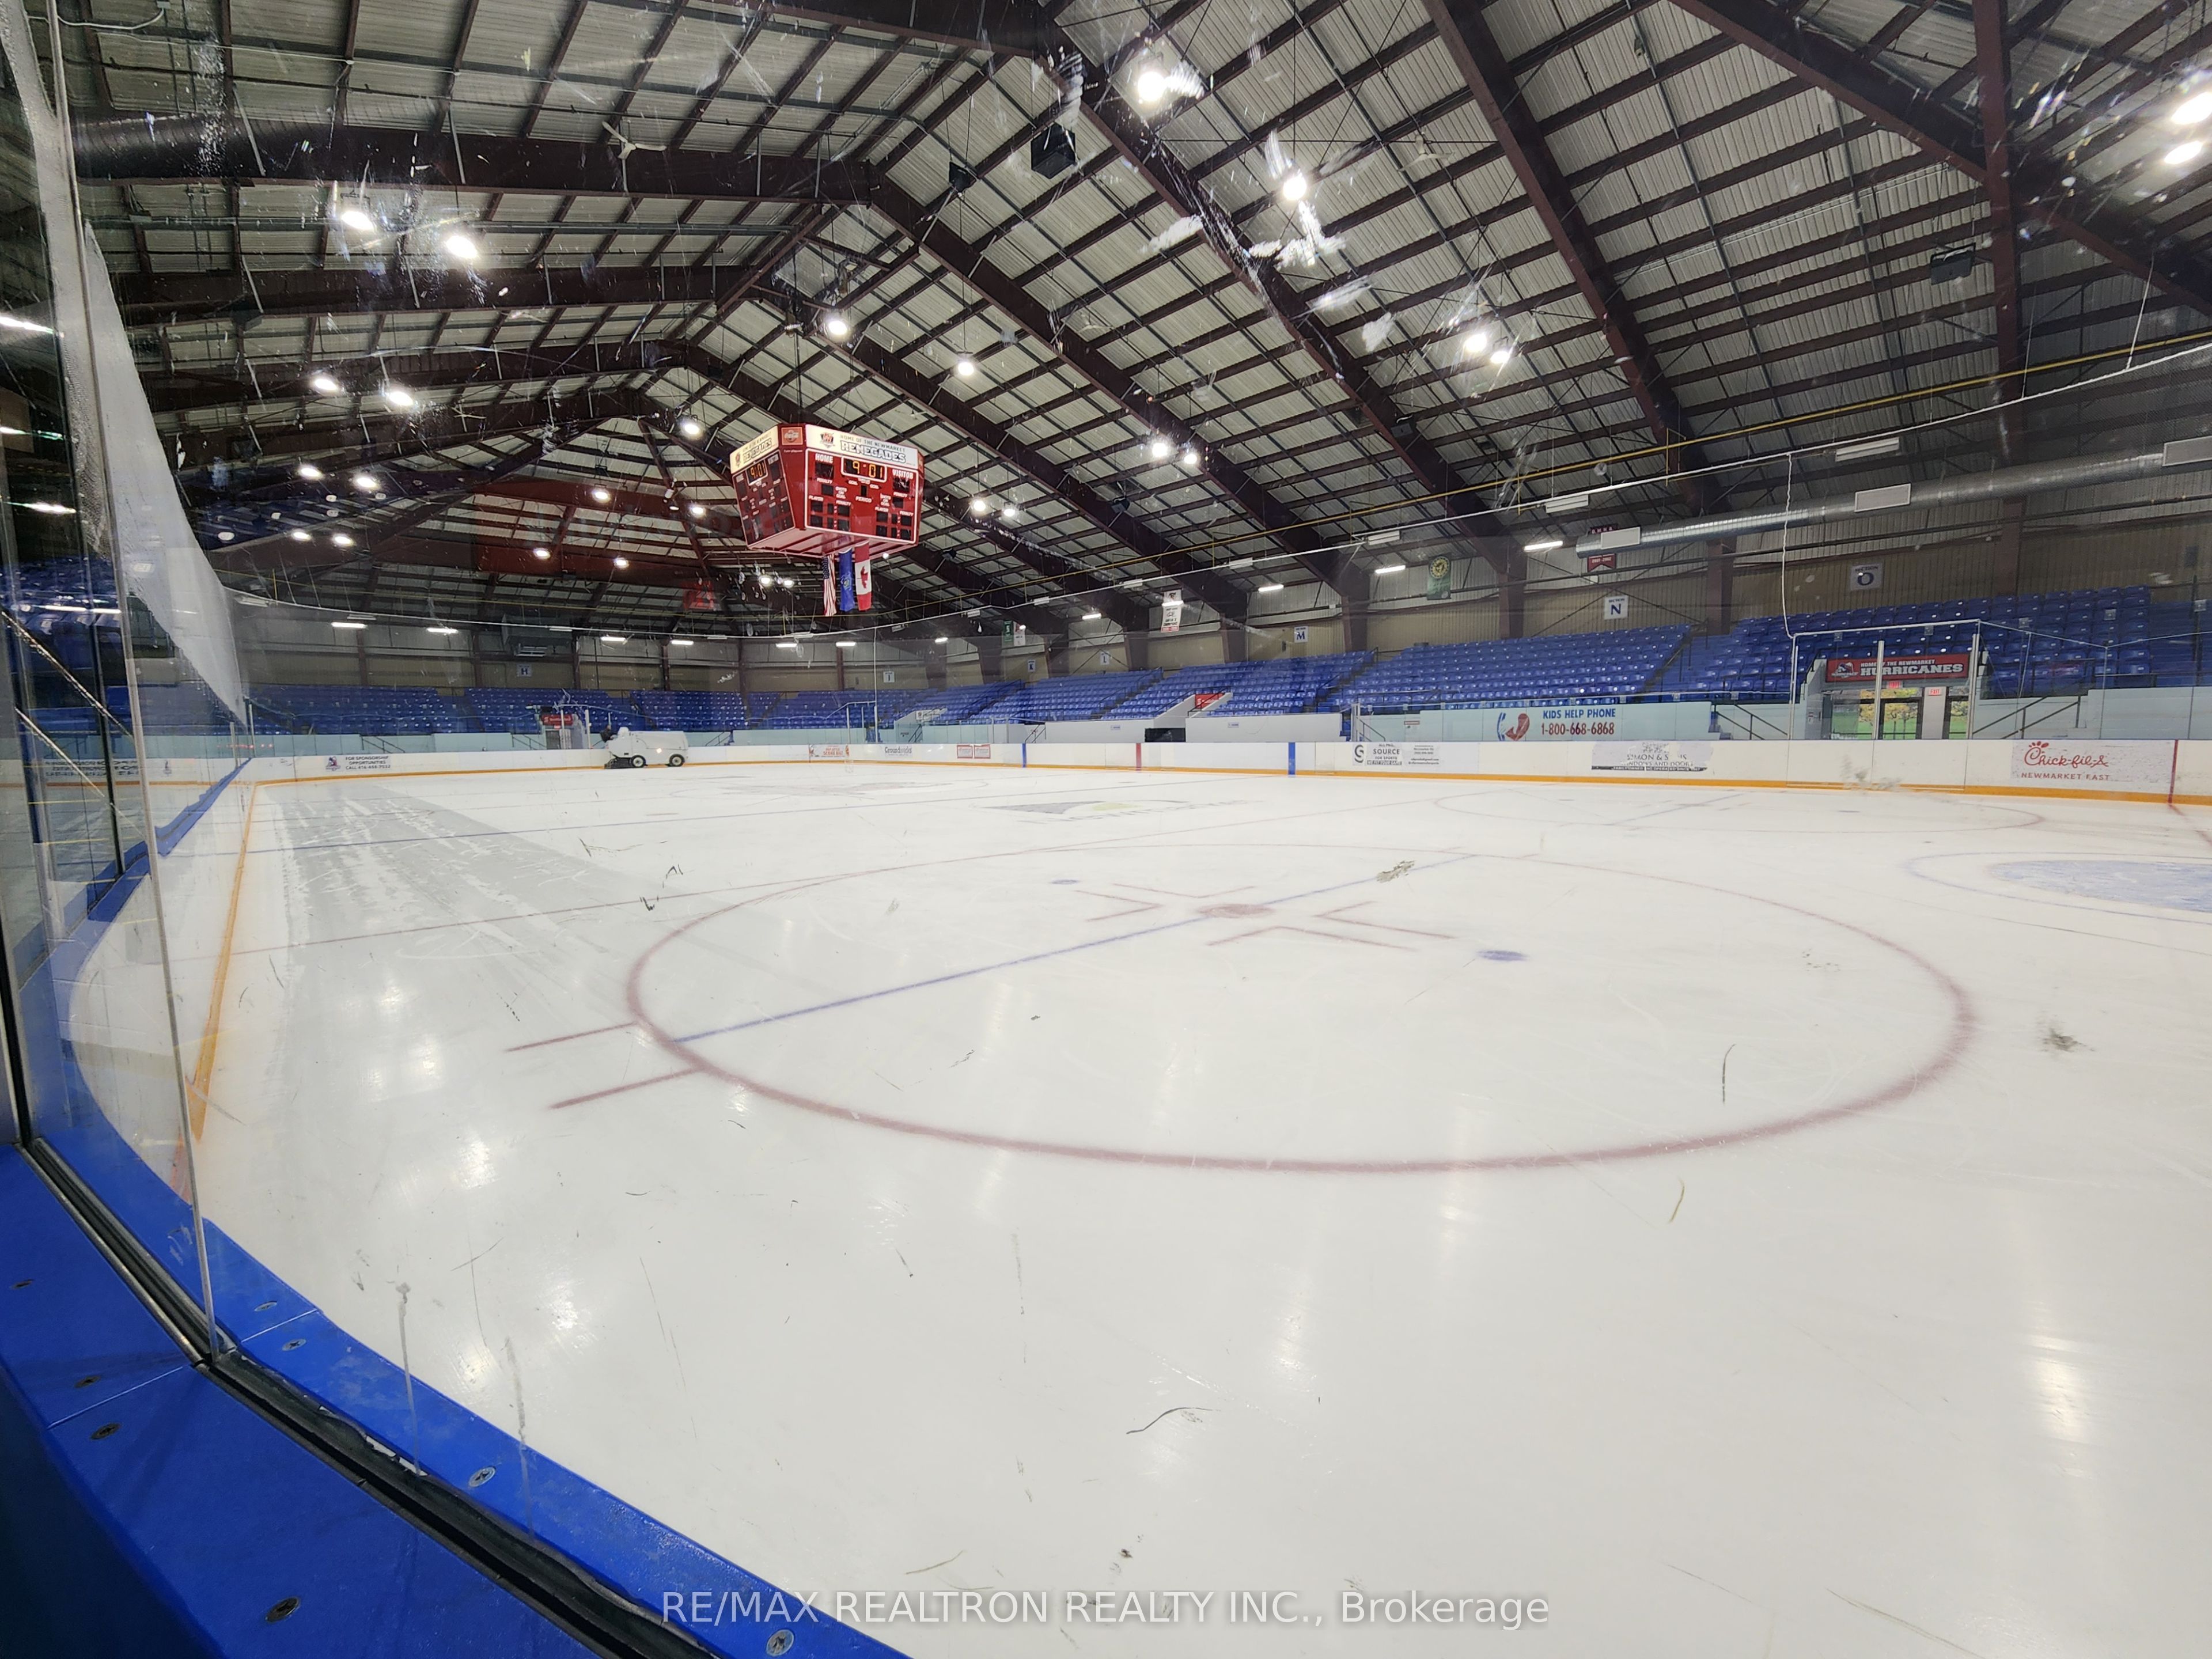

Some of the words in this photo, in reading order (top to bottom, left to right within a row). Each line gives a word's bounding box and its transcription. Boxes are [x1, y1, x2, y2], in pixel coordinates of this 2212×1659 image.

[840, 440, 906, 463] RENEGADES
[874, 442, 906, 453] NEWMARKET
[815, 453, 834, 463] HOME
[892, 468, 914, 479] VISITOR
[1857, 572, 1874, 586] O
[1611, 603, 1622, 615] N
[1297, 631, 1305, 640] M
[1543, 710, 1562, 719] KIDS
[1565, 709, 1584, 718] HELP
[1587, 709, 1616, 718] PHONE
[1541, 722, 1615, 735] 1-800-668-6868
[2024, 747, 2109, 768] Chick-fil-A
